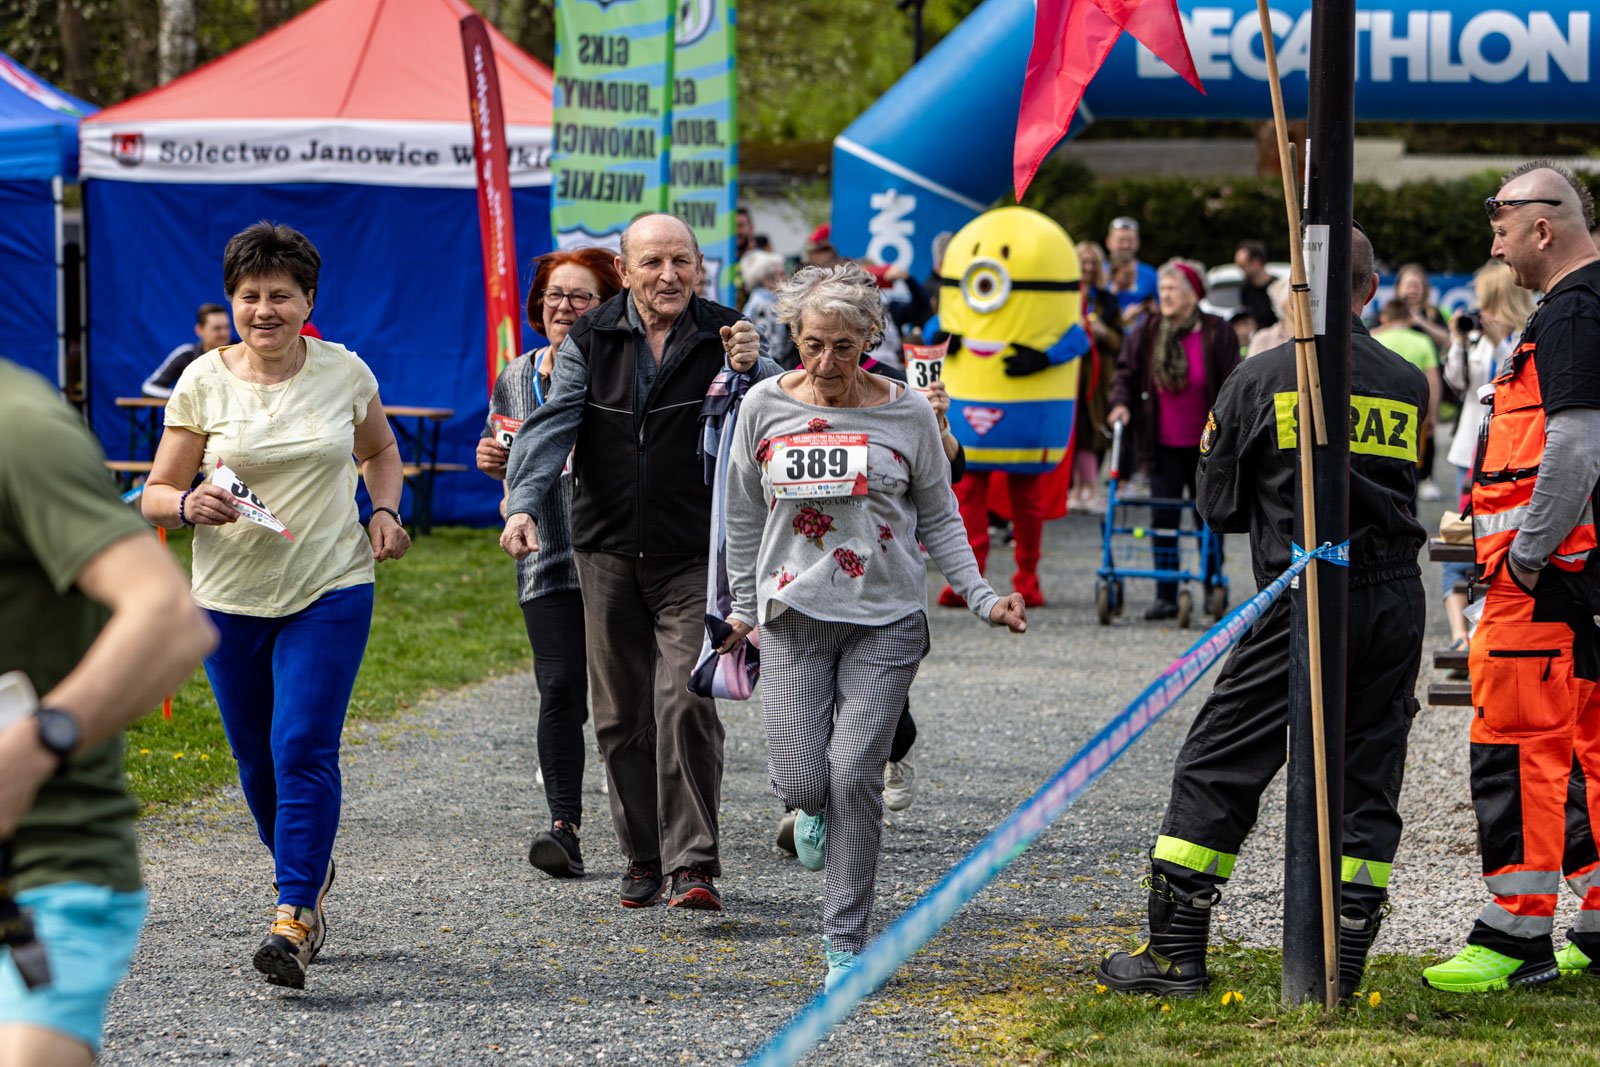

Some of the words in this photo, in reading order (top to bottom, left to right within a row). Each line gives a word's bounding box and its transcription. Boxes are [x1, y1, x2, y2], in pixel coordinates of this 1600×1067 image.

[1137, 8, 1590, 83] ECAHLON
[301, 140, 440, 166] Janowice
[786, 448, 848, 480] 389
